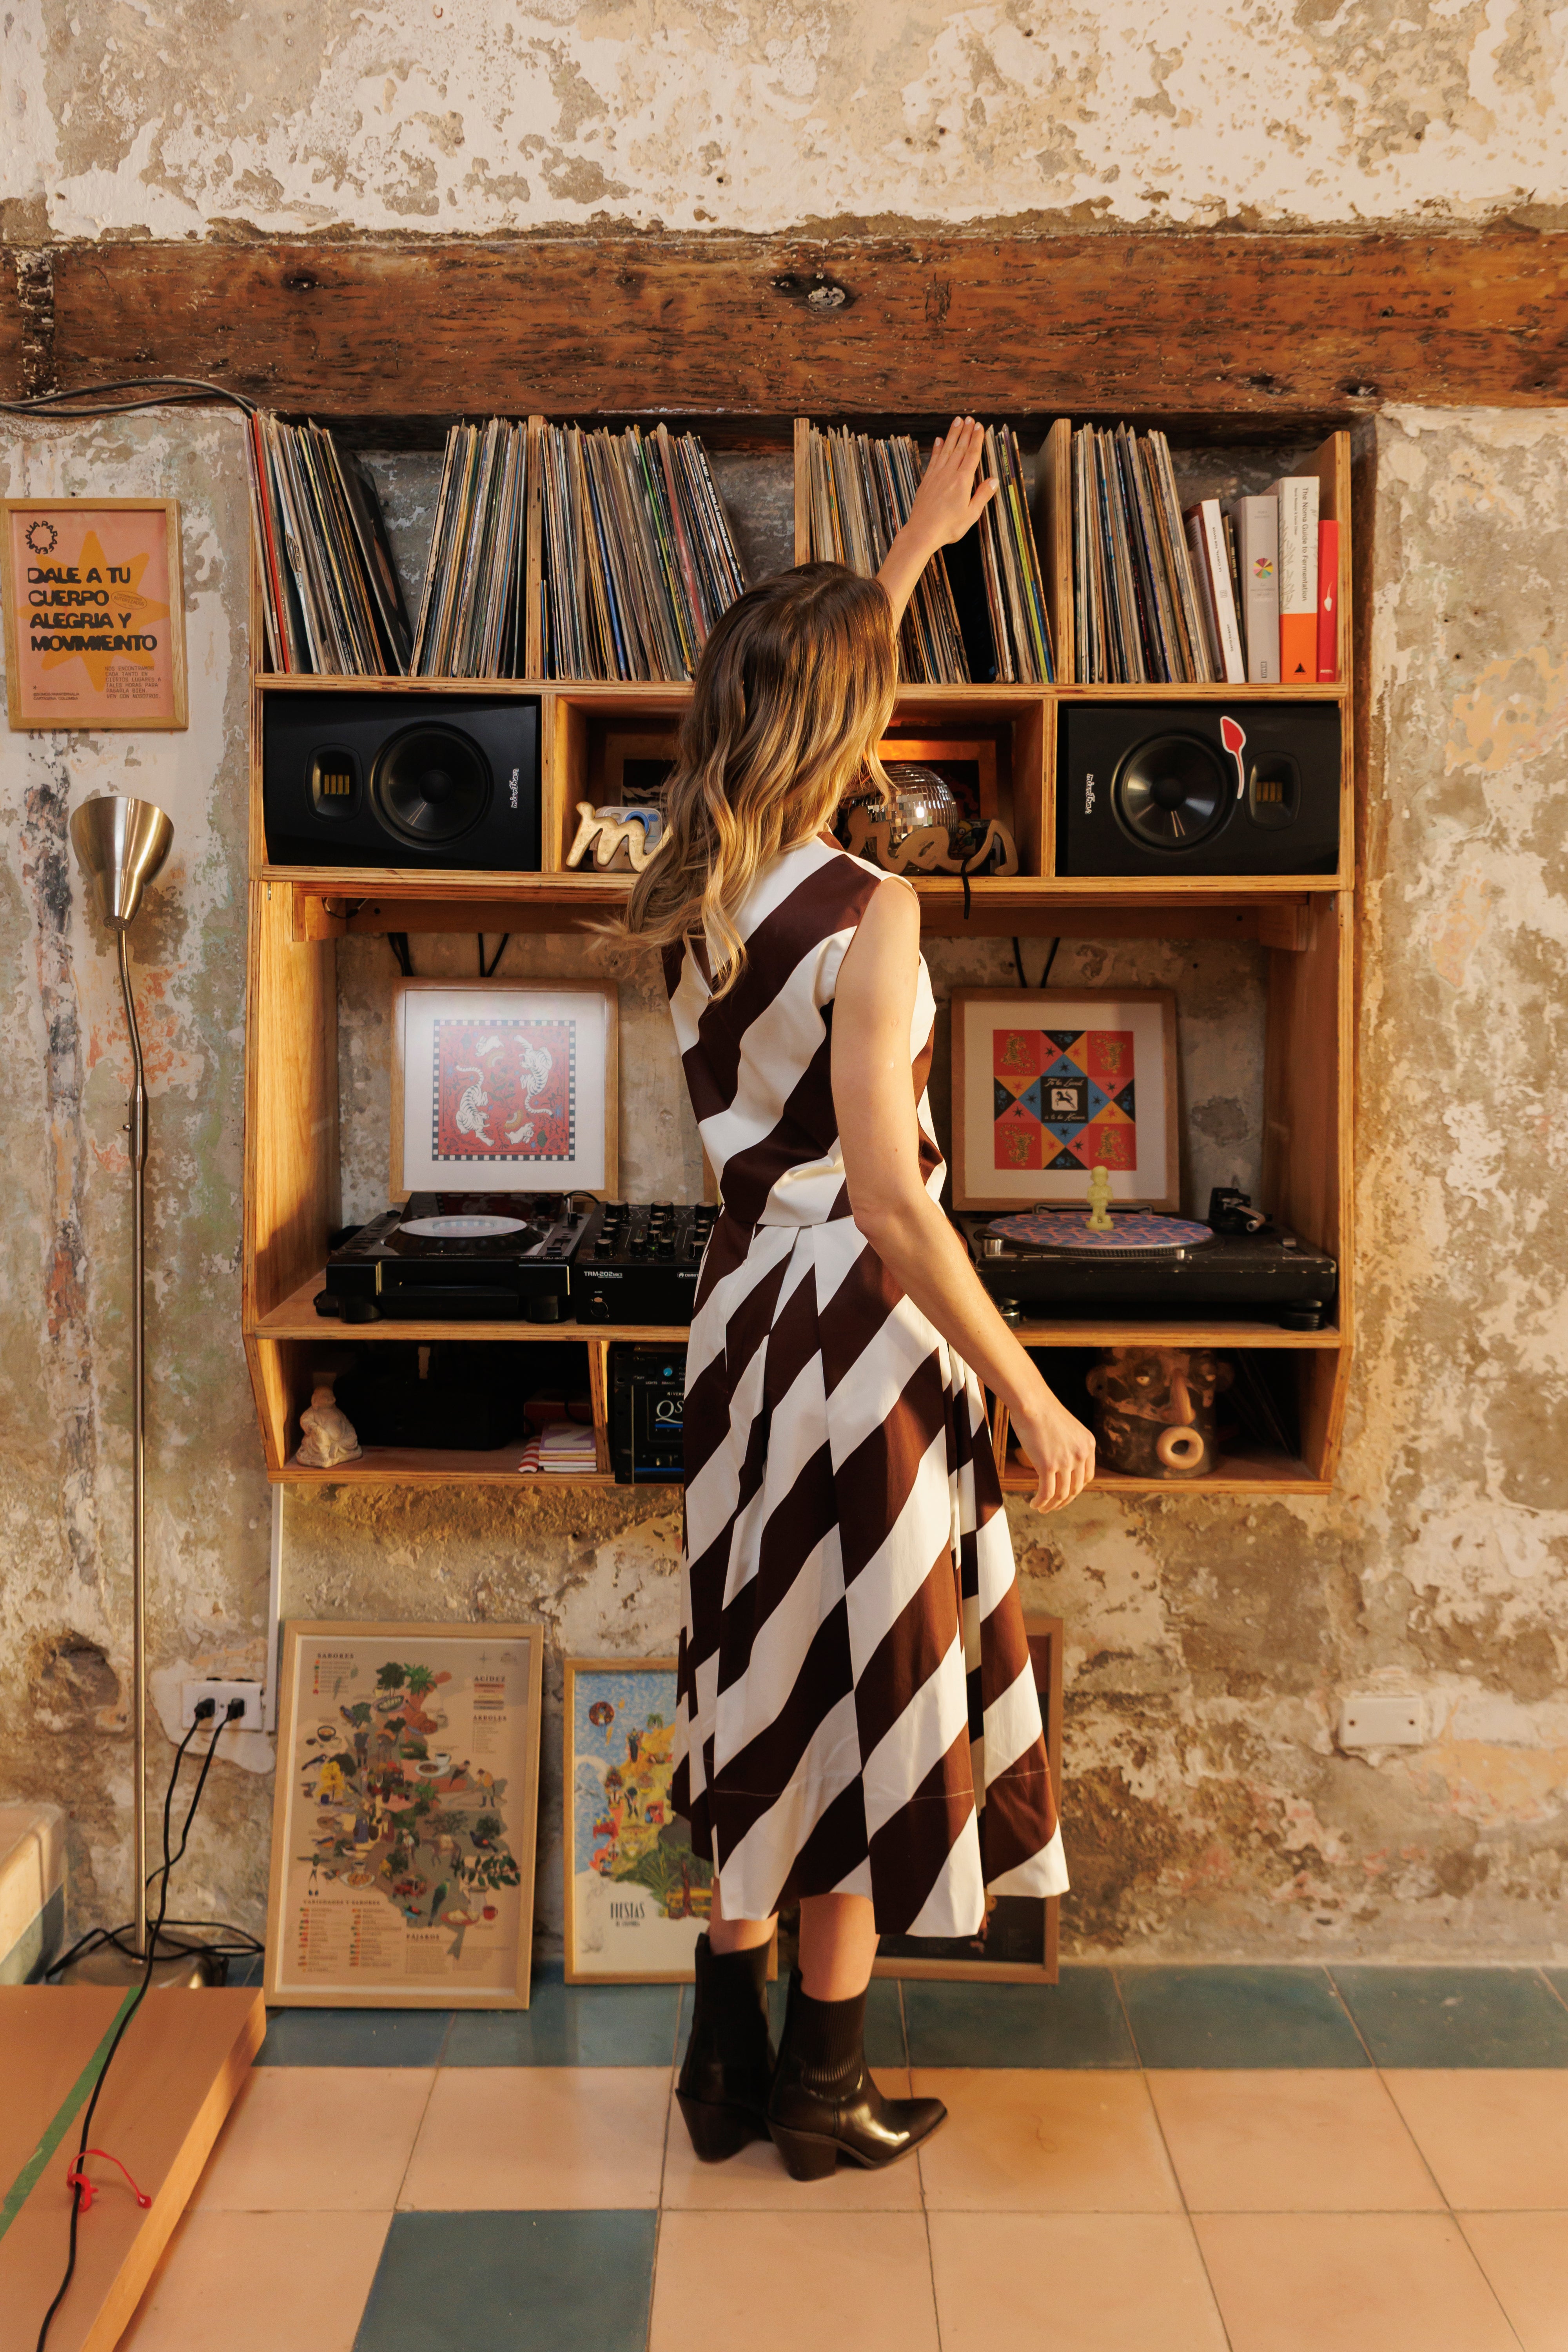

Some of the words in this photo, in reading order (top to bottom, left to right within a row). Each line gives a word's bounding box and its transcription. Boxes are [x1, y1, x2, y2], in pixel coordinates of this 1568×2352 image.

[27, 568, 82, 584] DALE
[86, 568, 102, 583] A
[107, 567, 131, 584] TU
[28, 590, 109, 606] CUERPO
[30, 613, 114, 629] ALEGRIA
[118, 613, 132, 628] Y
[31, 635, 158, 652] MOVIMIENTO
[655, 1400, 684, 1424] QS
